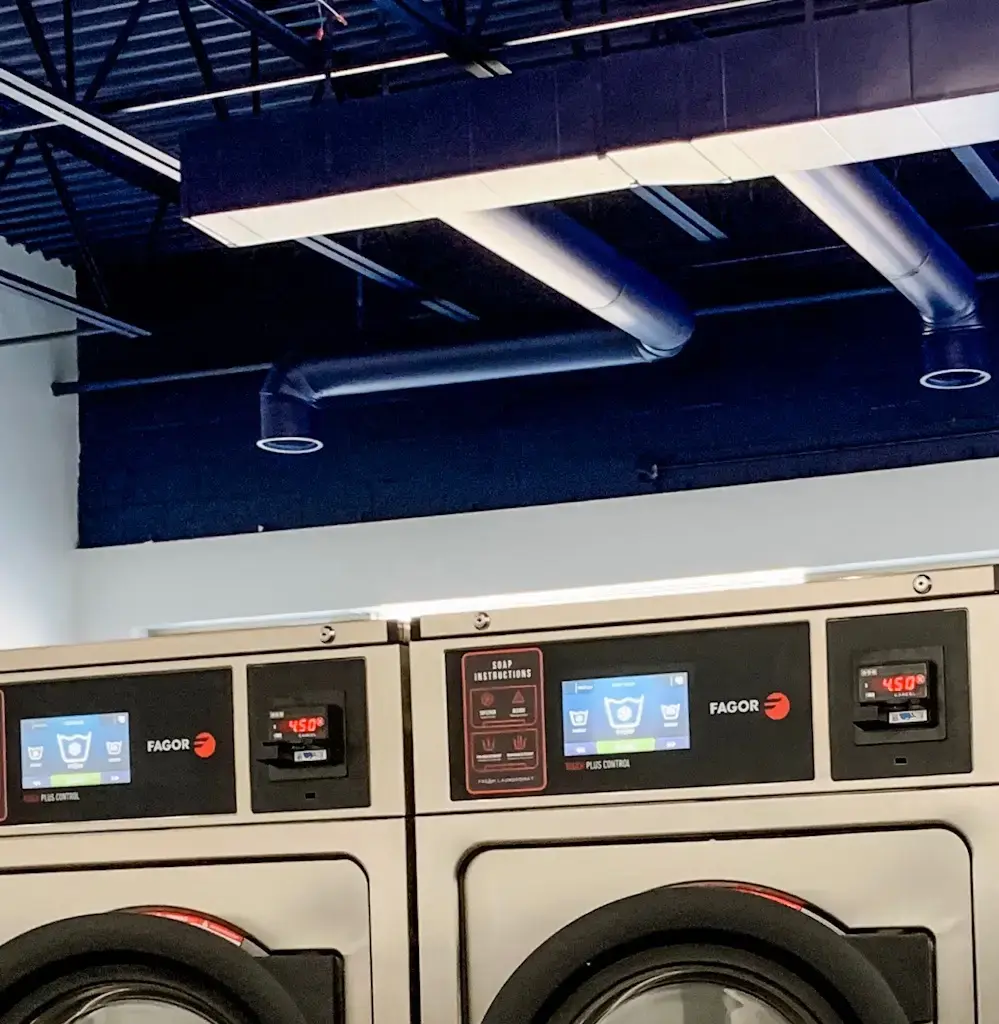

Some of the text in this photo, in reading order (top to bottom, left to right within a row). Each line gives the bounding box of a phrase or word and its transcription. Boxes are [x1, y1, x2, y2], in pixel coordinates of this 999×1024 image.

[492, 659, 513, 670] SOAP
[474, 669, 532, 682] INSTRUCTIONS
[709, 699, 759, 715] FAGOR
[146, 738, 190, 752] FAGOR
[585, 760, 602, 770] PLUS
[603, 759, 630, 769] CONTROL
